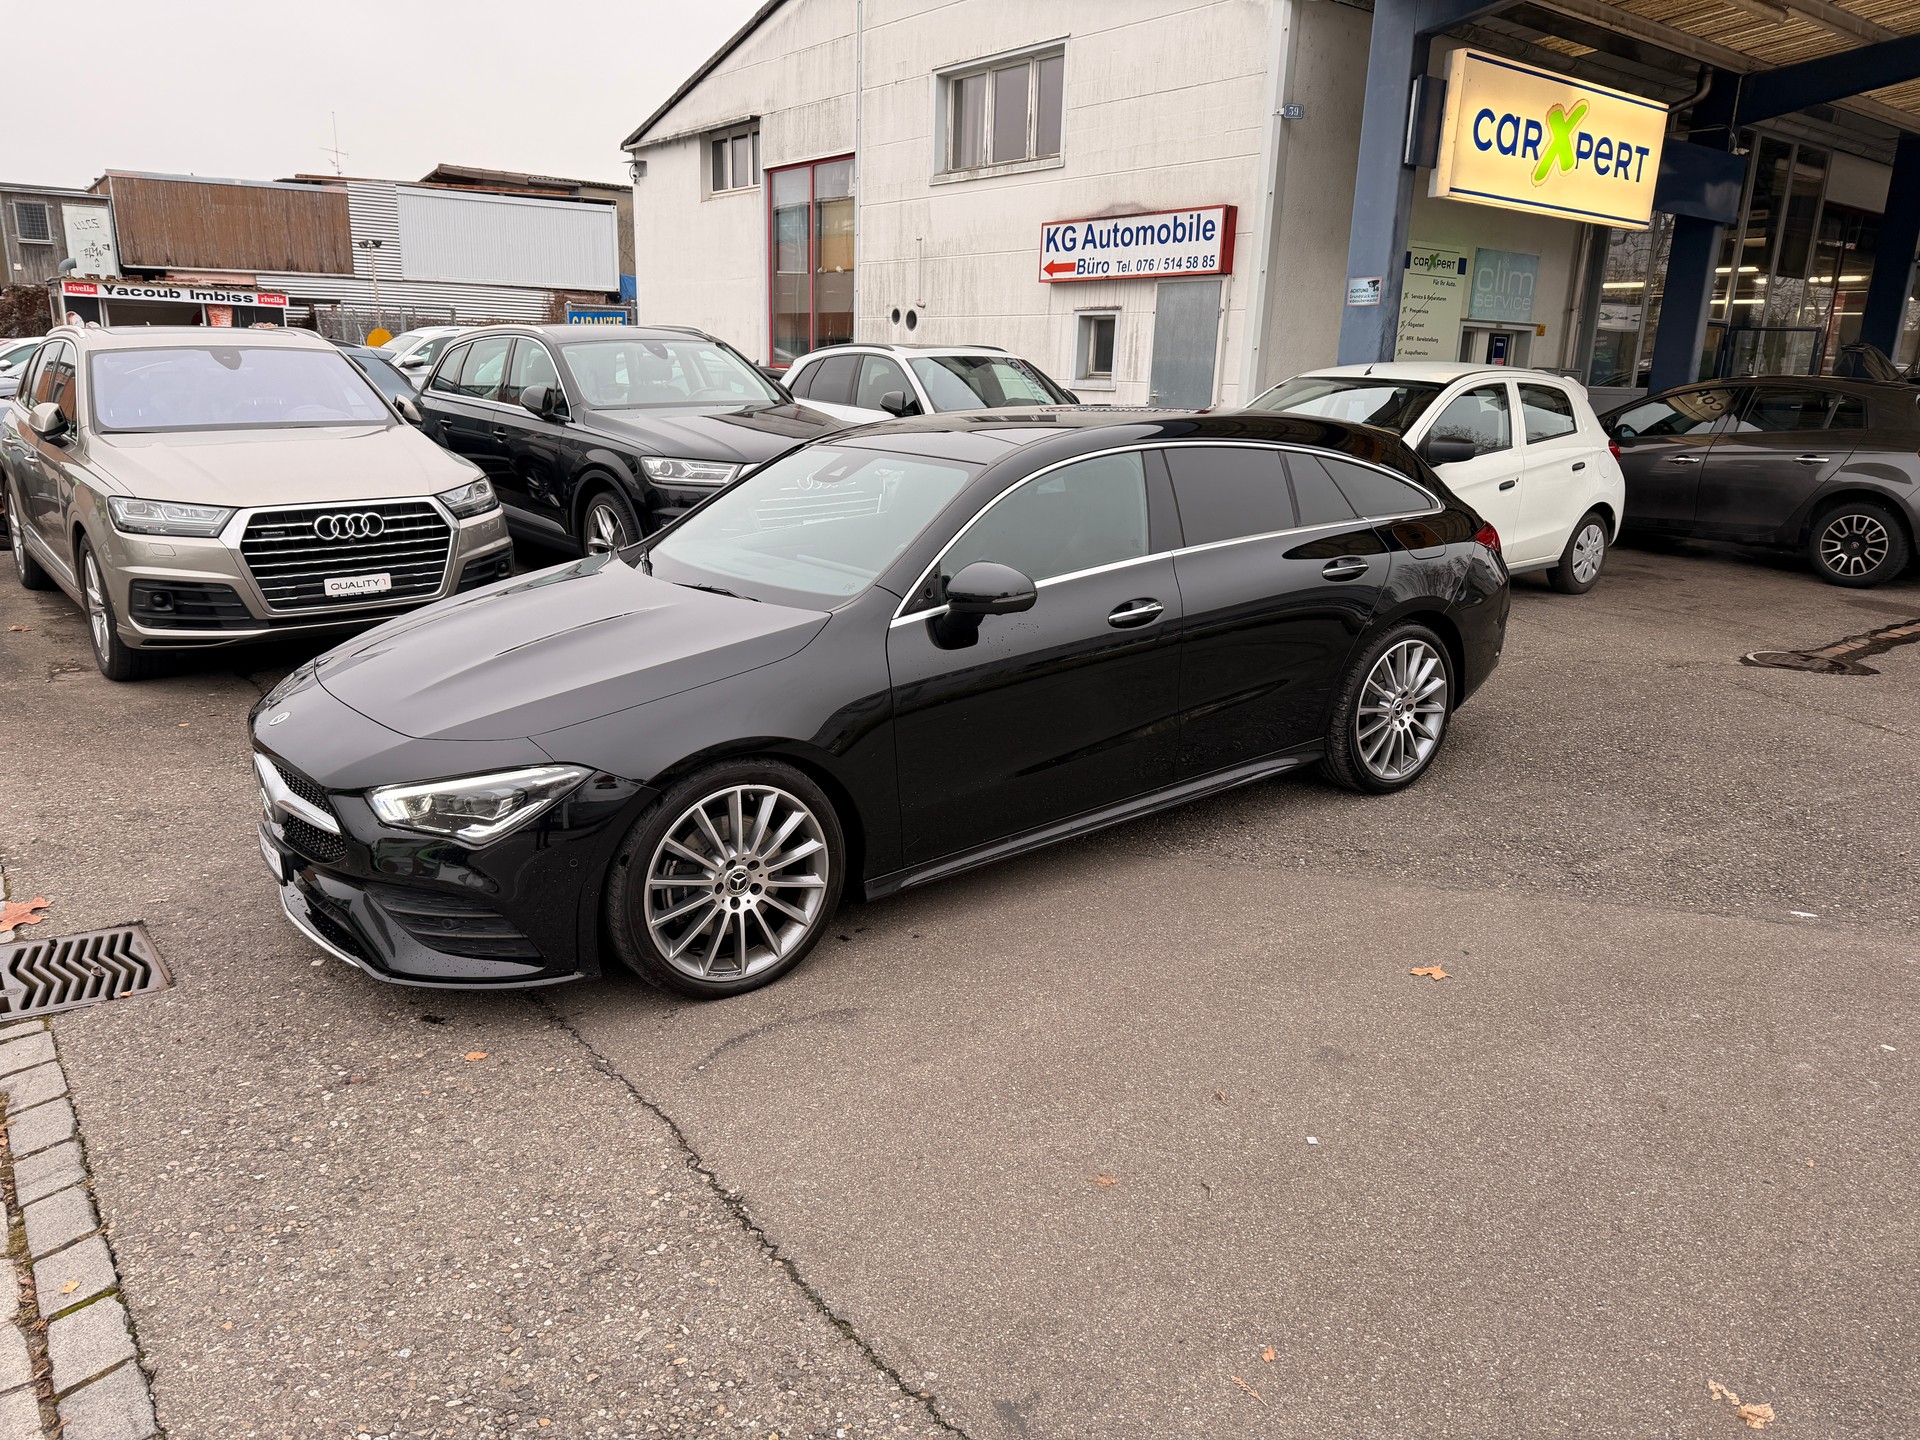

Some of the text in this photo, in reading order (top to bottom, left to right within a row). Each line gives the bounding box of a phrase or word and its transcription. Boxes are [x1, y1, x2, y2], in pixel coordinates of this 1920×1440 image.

[1045, 213, 1216, 253] KG Automobile
[1076, 257, 1110, 276] Büro
[1116, 260, 1133, 273] Tel.
[1136, 258, 1155, 272] 076
[1163, 256, 1183, 271] 514
[1185, 255, 1199, 270] 58
[1201, 254, 1216, 268] 85
[1477, 258, 1534, 298] clim
[67, 285, 95, 293] rivella
[103, 284, 254, 304] Yacoub Imbiss
[260, 296, 284, 304] rivella
[1474, 292, 1532, 311] service
[331, 579, 380, 590] QUALITY
